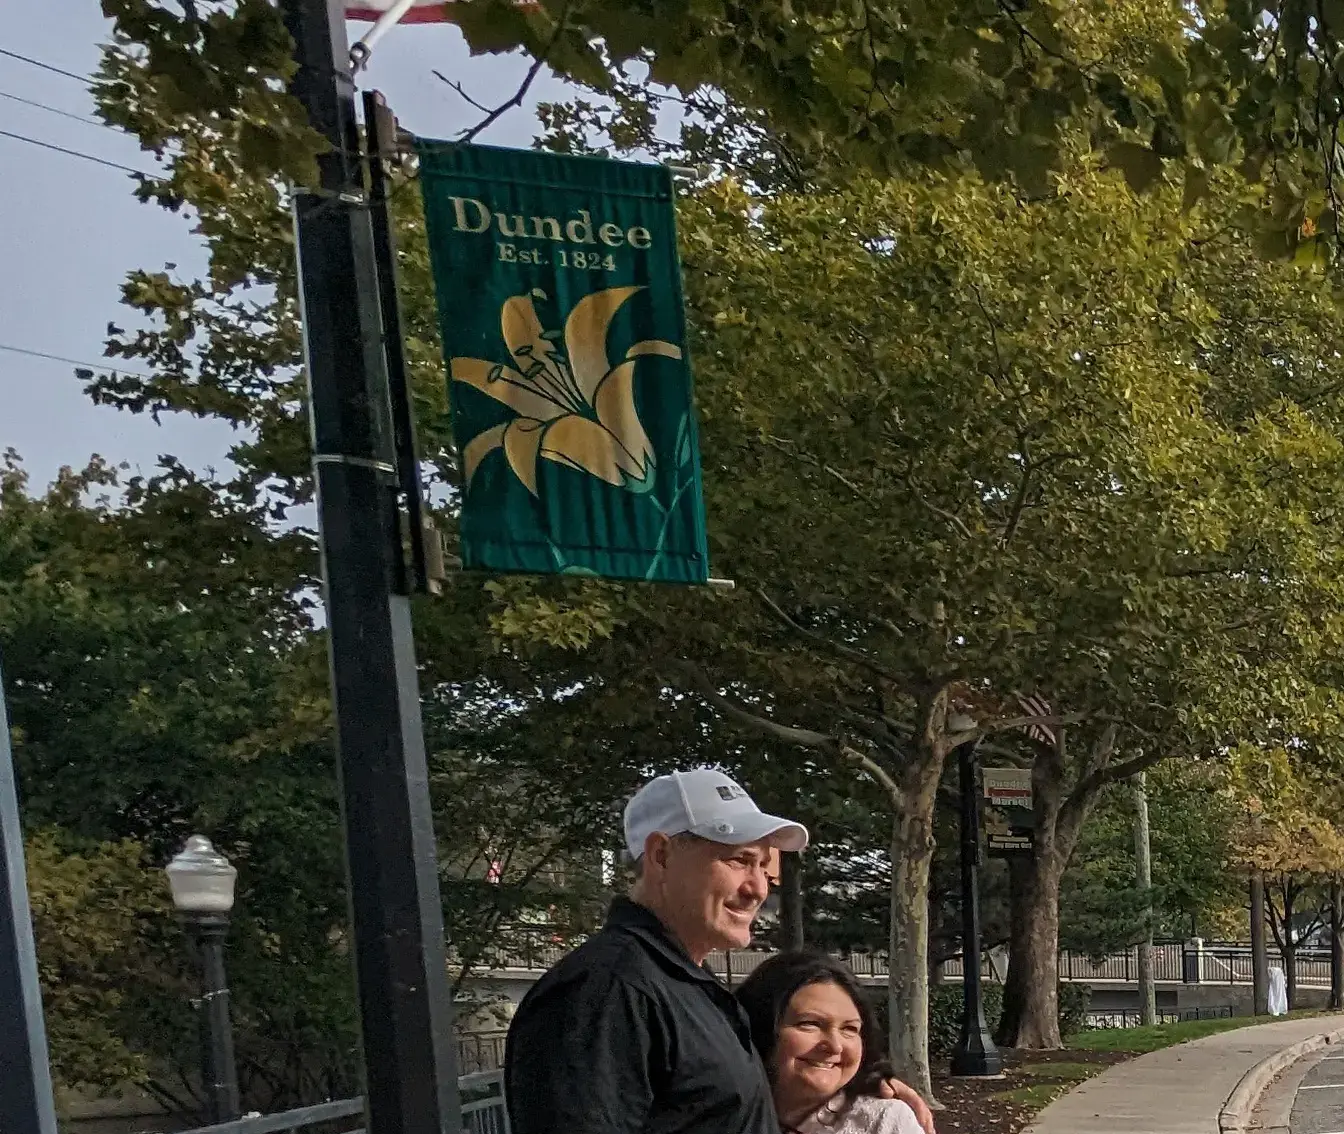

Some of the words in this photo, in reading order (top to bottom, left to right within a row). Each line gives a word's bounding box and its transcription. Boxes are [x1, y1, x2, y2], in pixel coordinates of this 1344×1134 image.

[448, 196, 652, 249] Dundee
[496, 242, 549, 265] Est.
[559, 250, 616, 272] 1824
